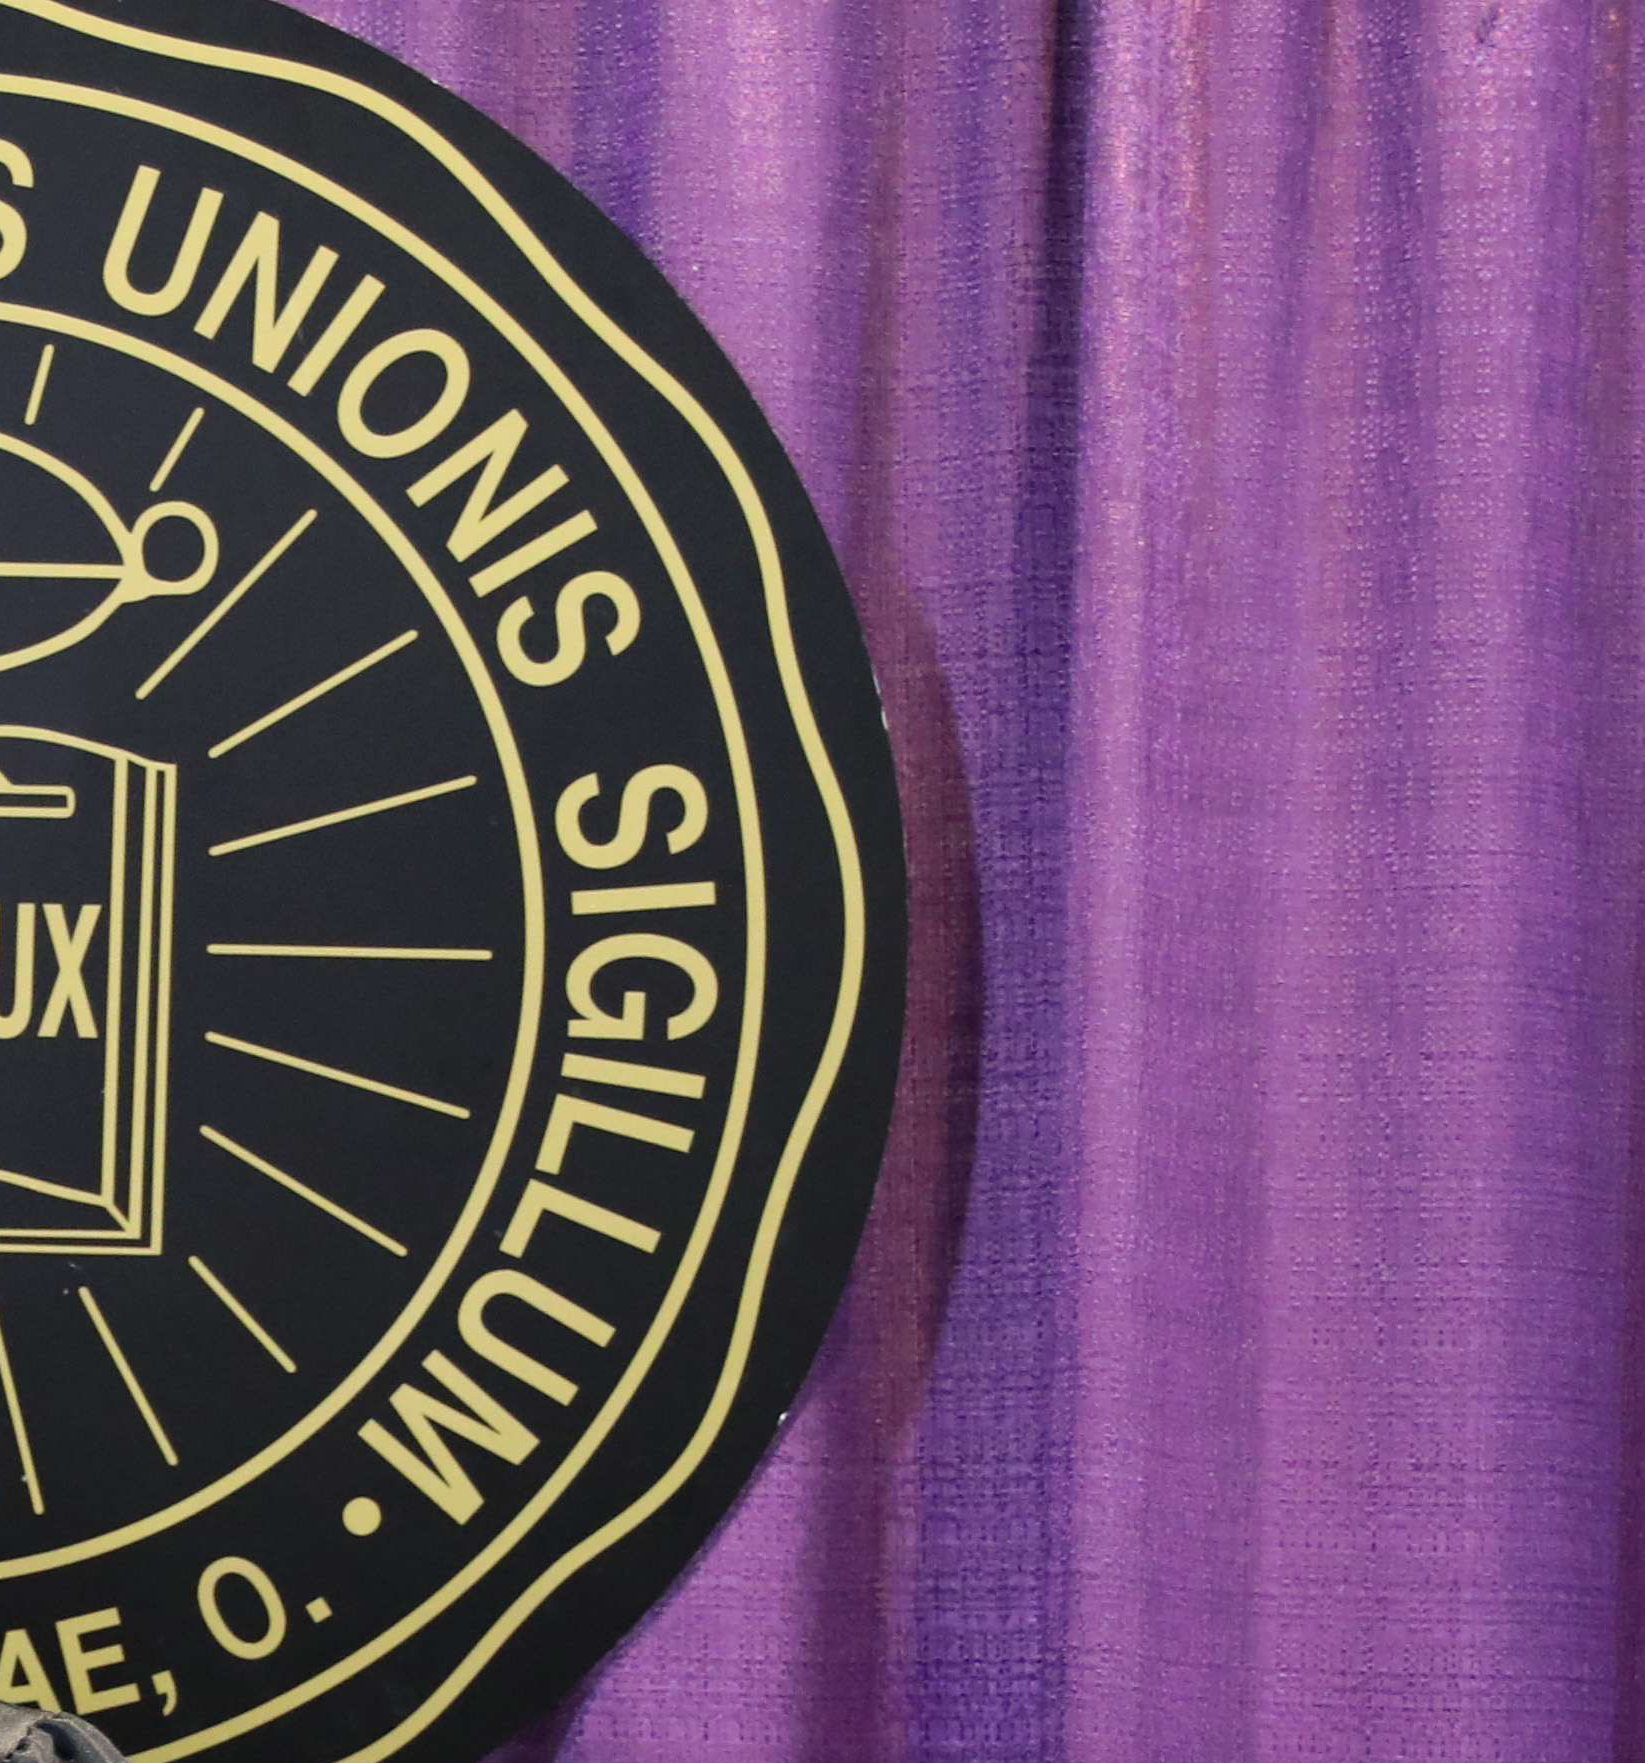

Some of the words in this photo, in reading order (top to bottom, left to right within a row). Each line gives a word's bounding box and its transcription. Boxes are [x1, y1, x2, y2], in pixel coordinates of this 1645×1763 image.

[103, 166, 640, 686] UNIONIS
[358, 765, 717, 1524] SIGILLUM
[198, 1557, 332, 1659] O.
